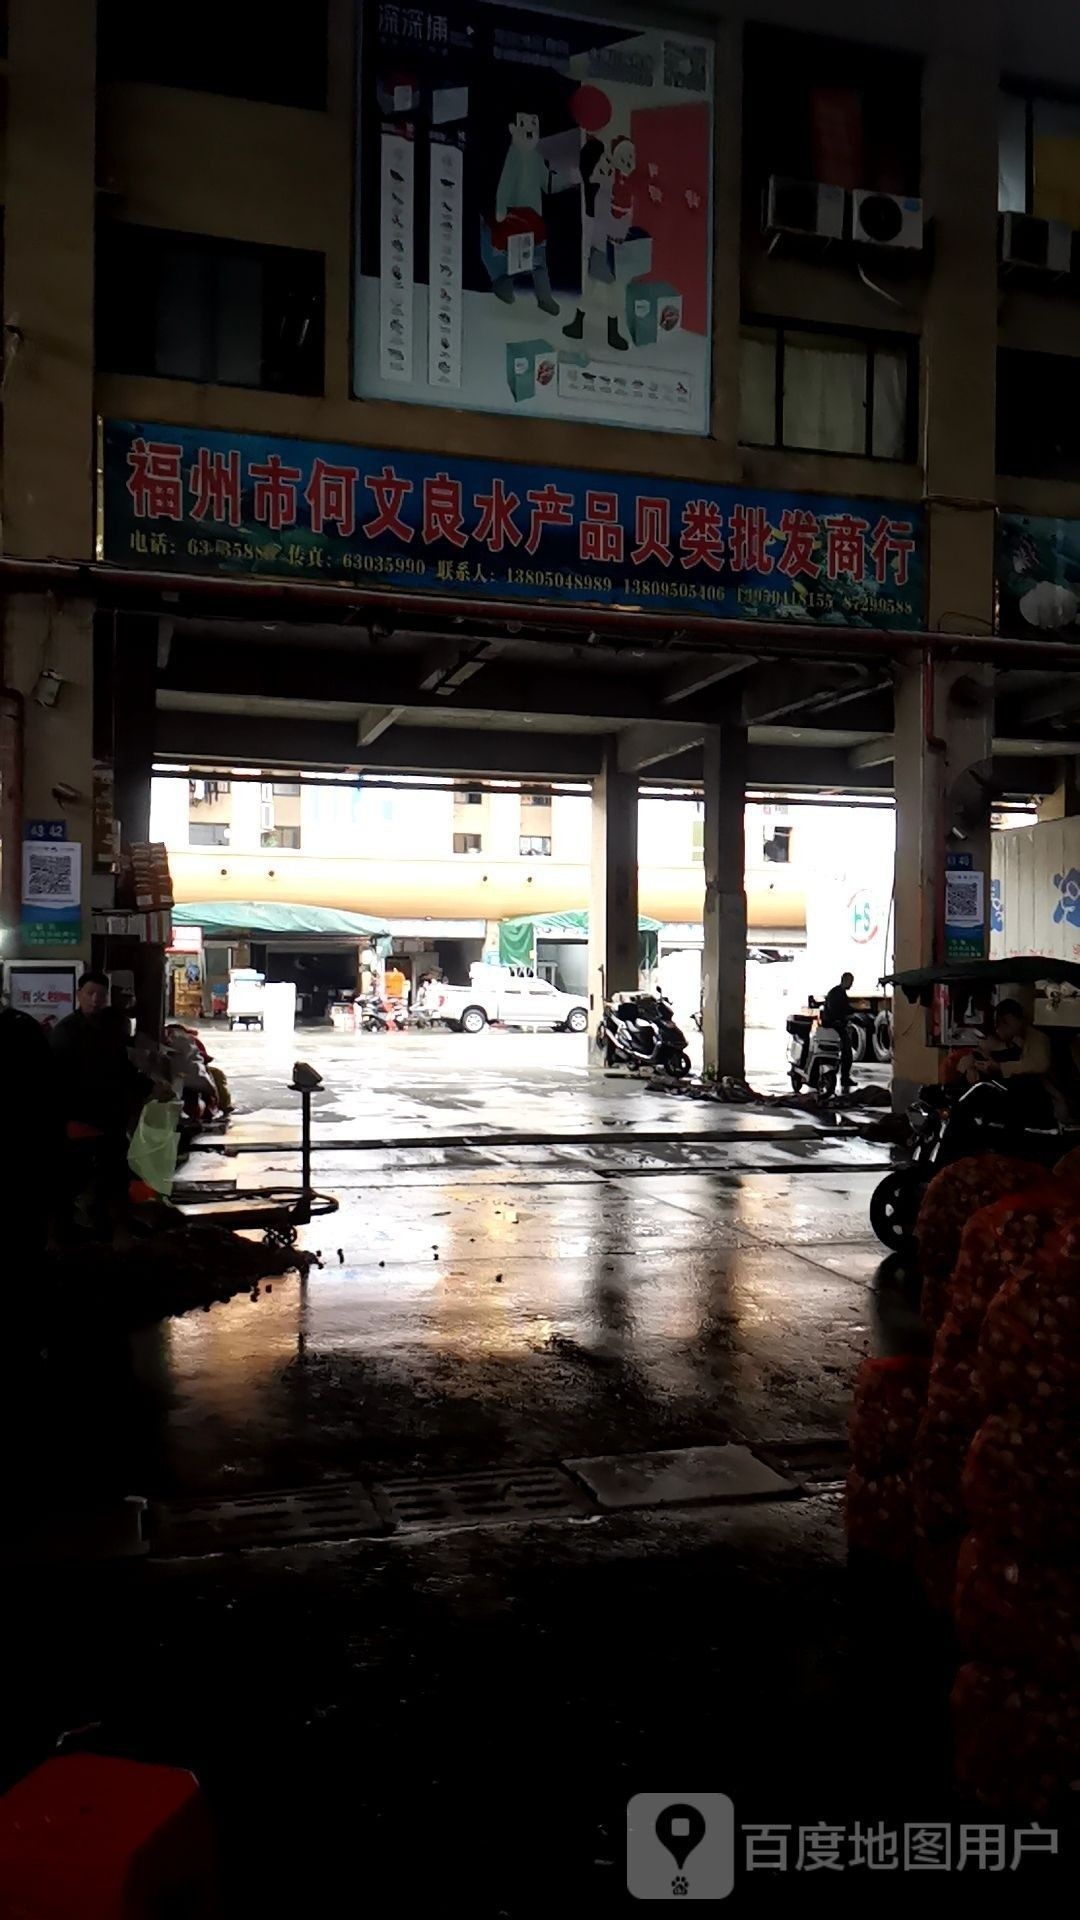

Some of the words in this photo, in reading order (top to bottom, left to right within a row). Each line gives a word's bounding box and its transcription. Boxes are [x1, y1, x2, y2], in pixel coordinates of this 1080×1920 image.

[126, 439, 915, 587] 福州市何文良水产品贝类批发商行
[343, 551, 427, 577] 63035990
[506, 567, 613, 592] 13805048989
[623, 577, 726, 601] 13809505406
[48, 824, 64, 838] 42
